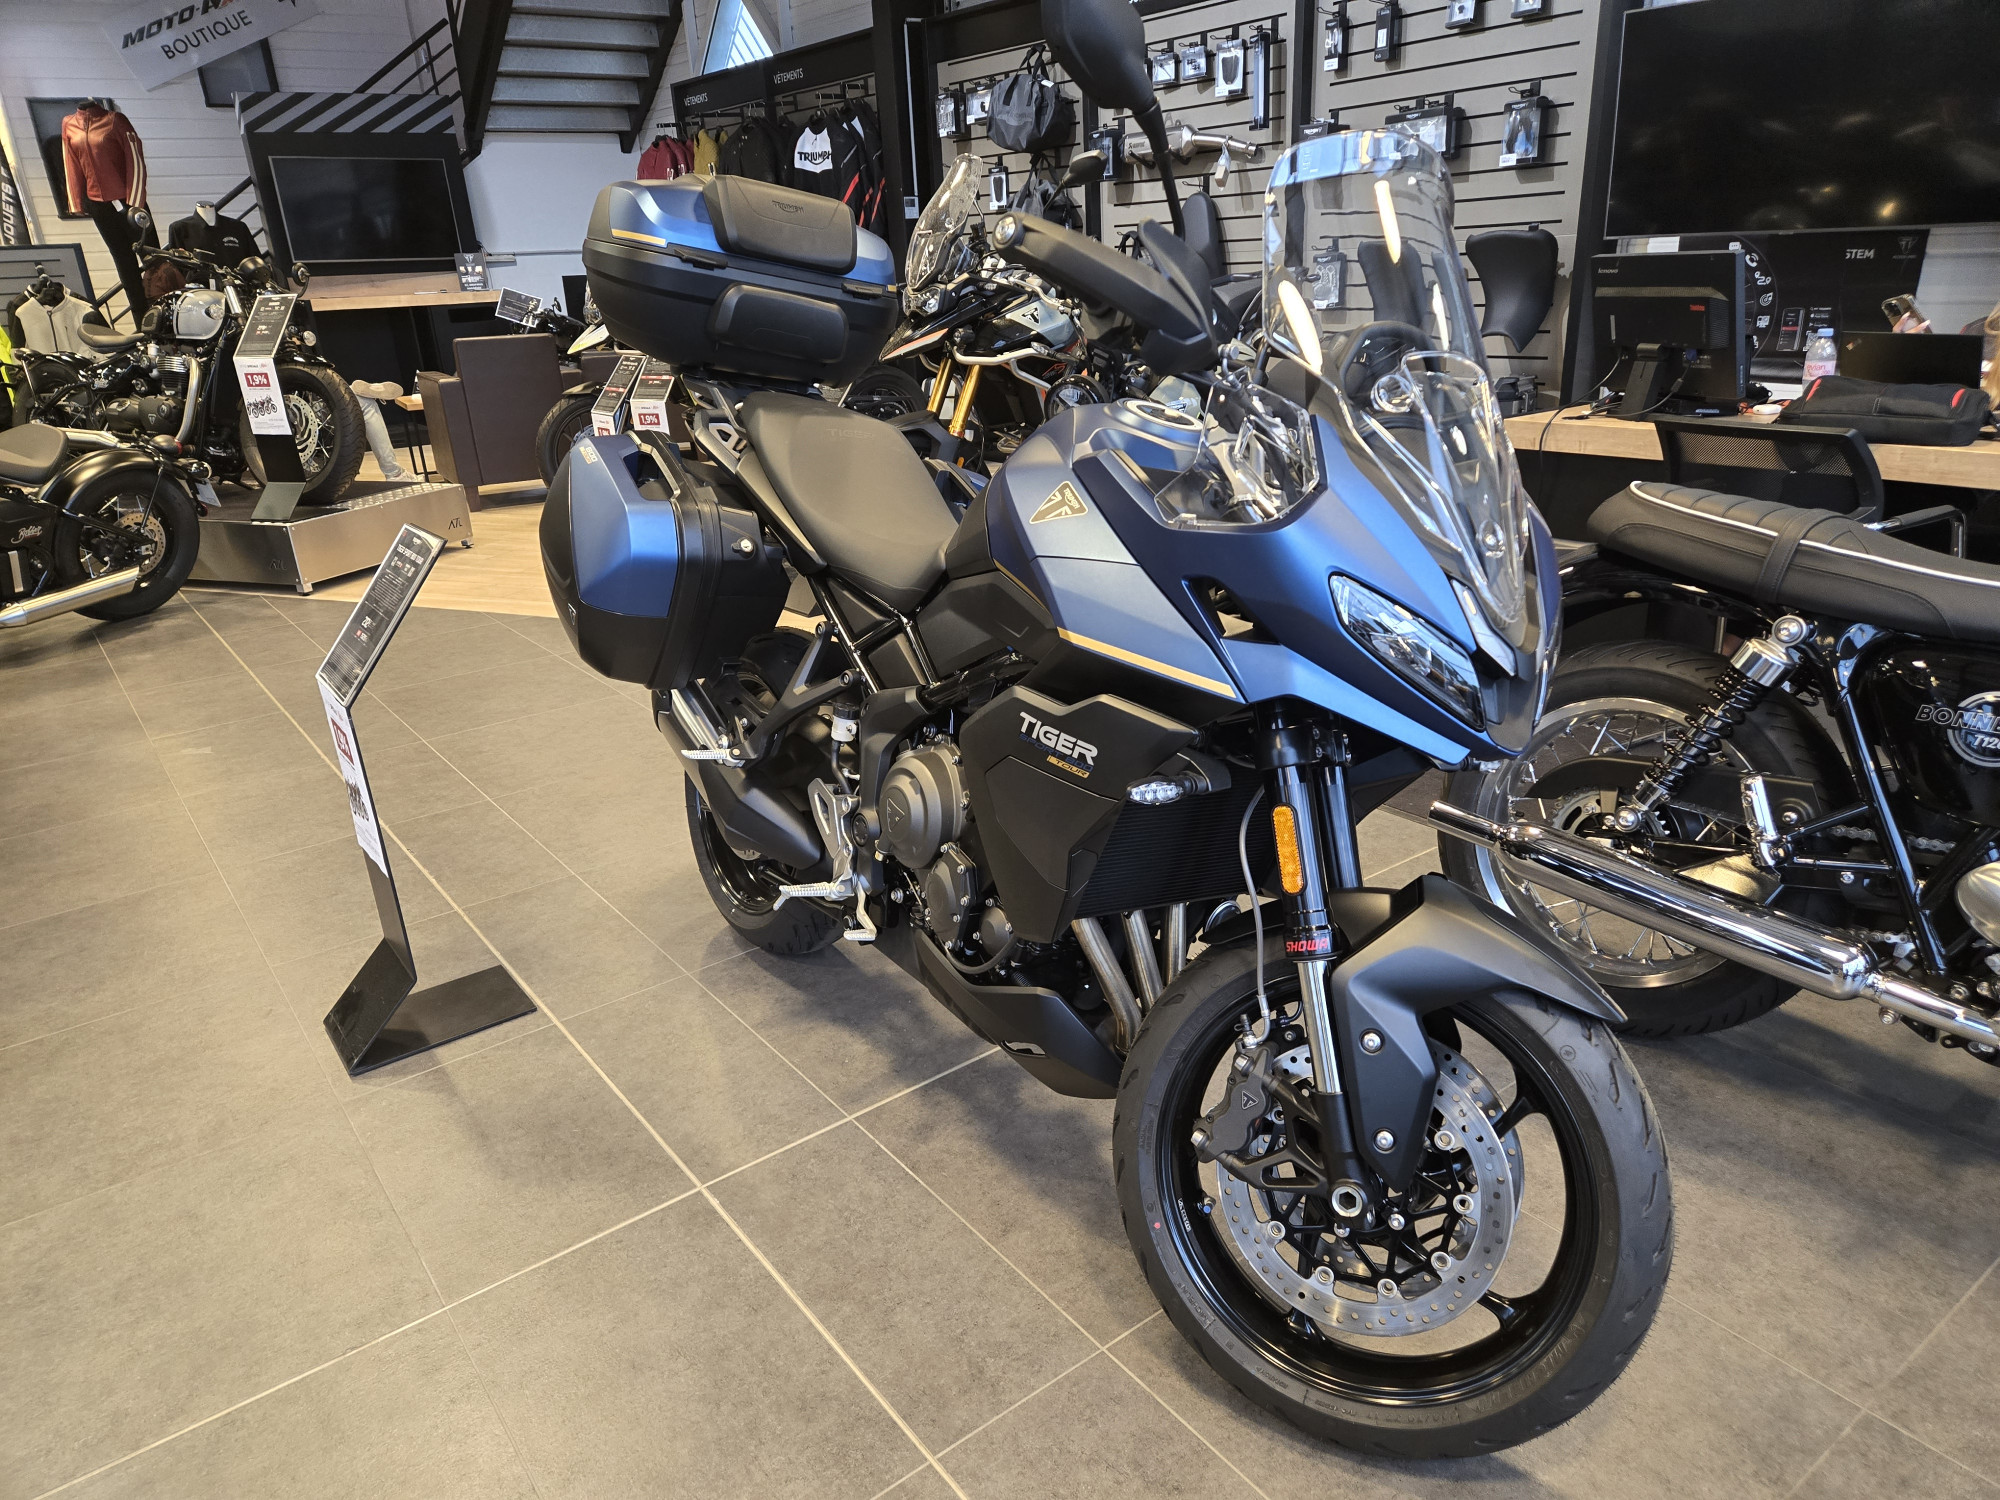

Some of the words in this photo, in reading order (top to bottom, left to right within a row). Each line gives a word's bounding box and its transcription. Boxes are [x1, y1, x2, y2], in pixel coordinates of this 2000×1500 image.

[122, 0, 234, 49] MOTO-A
[161, 10, 252, 59] BOUTIQUE
[797, 150, 832, 165] TRIUMPH
[2, 181, 15, 245] JOUETS
[247, 374, 268, 386] 1,9%
[640, 415, 658, 425] 1,9%
[1019, 733, 1064, 758] SPORT
[1065, 756, 1094, 773] 800
[1020, 711, 1098, 766] TIGER
[1055, 758, 1088, 777] TOUR
[1286, 938, 1328, 952] SHOWA
